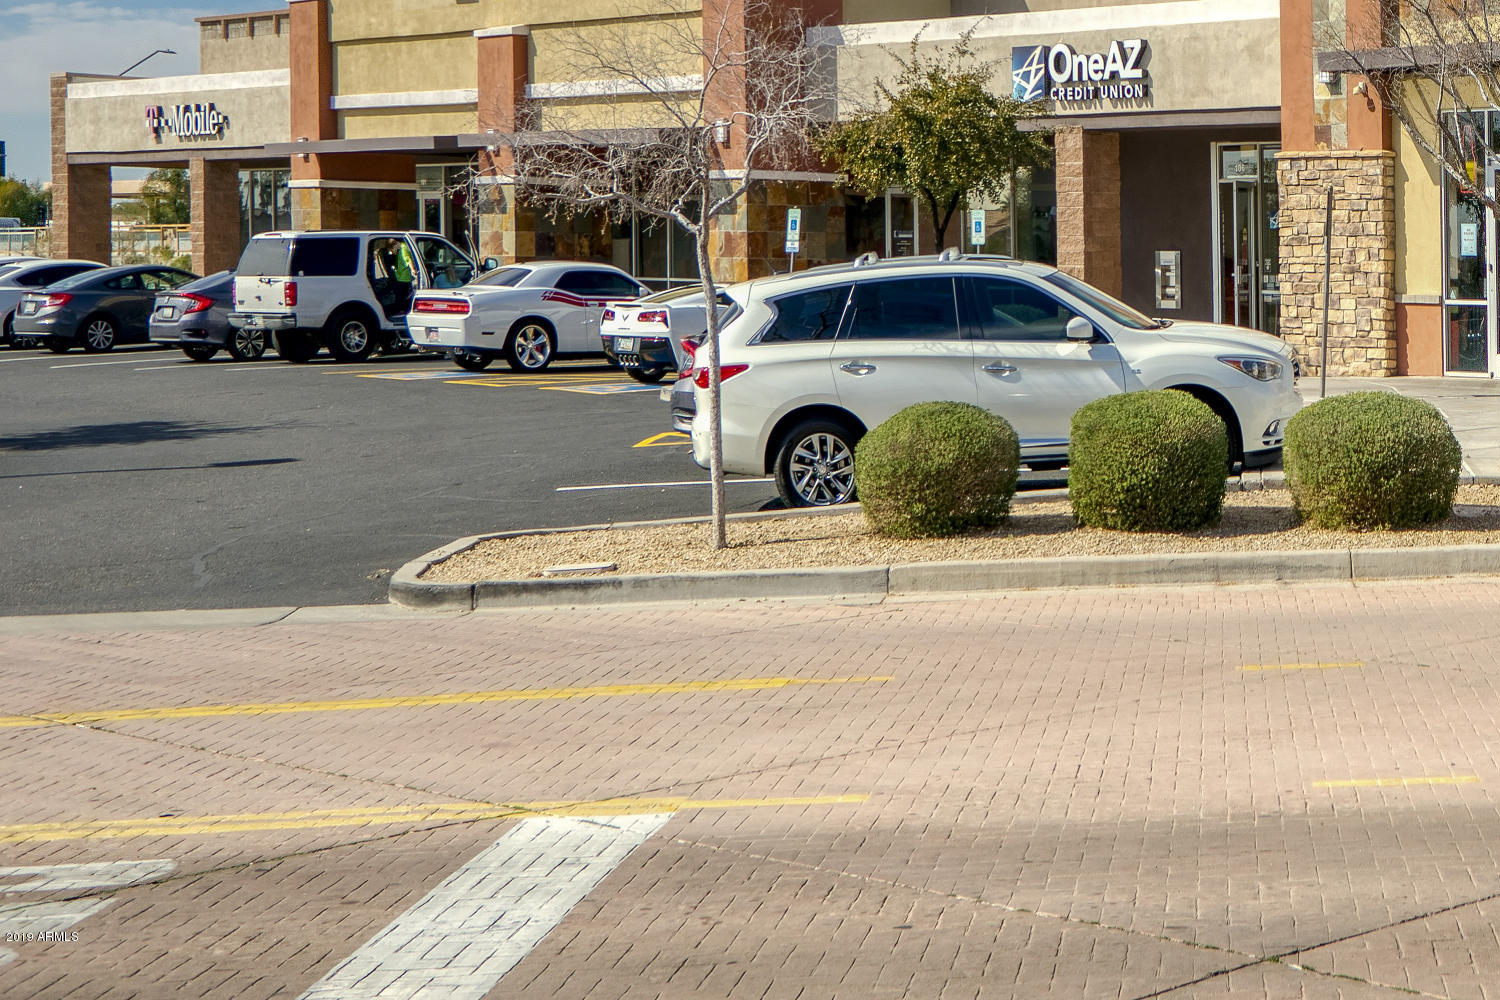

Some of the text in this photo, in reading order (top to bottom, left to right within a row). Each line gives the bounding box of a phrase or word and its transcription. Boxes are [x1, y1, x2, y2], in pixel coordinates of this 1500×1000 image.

[1048, 39, 1143, 83] OneAZ
[1050, 84, 1143, 101] CREDIT UNION
